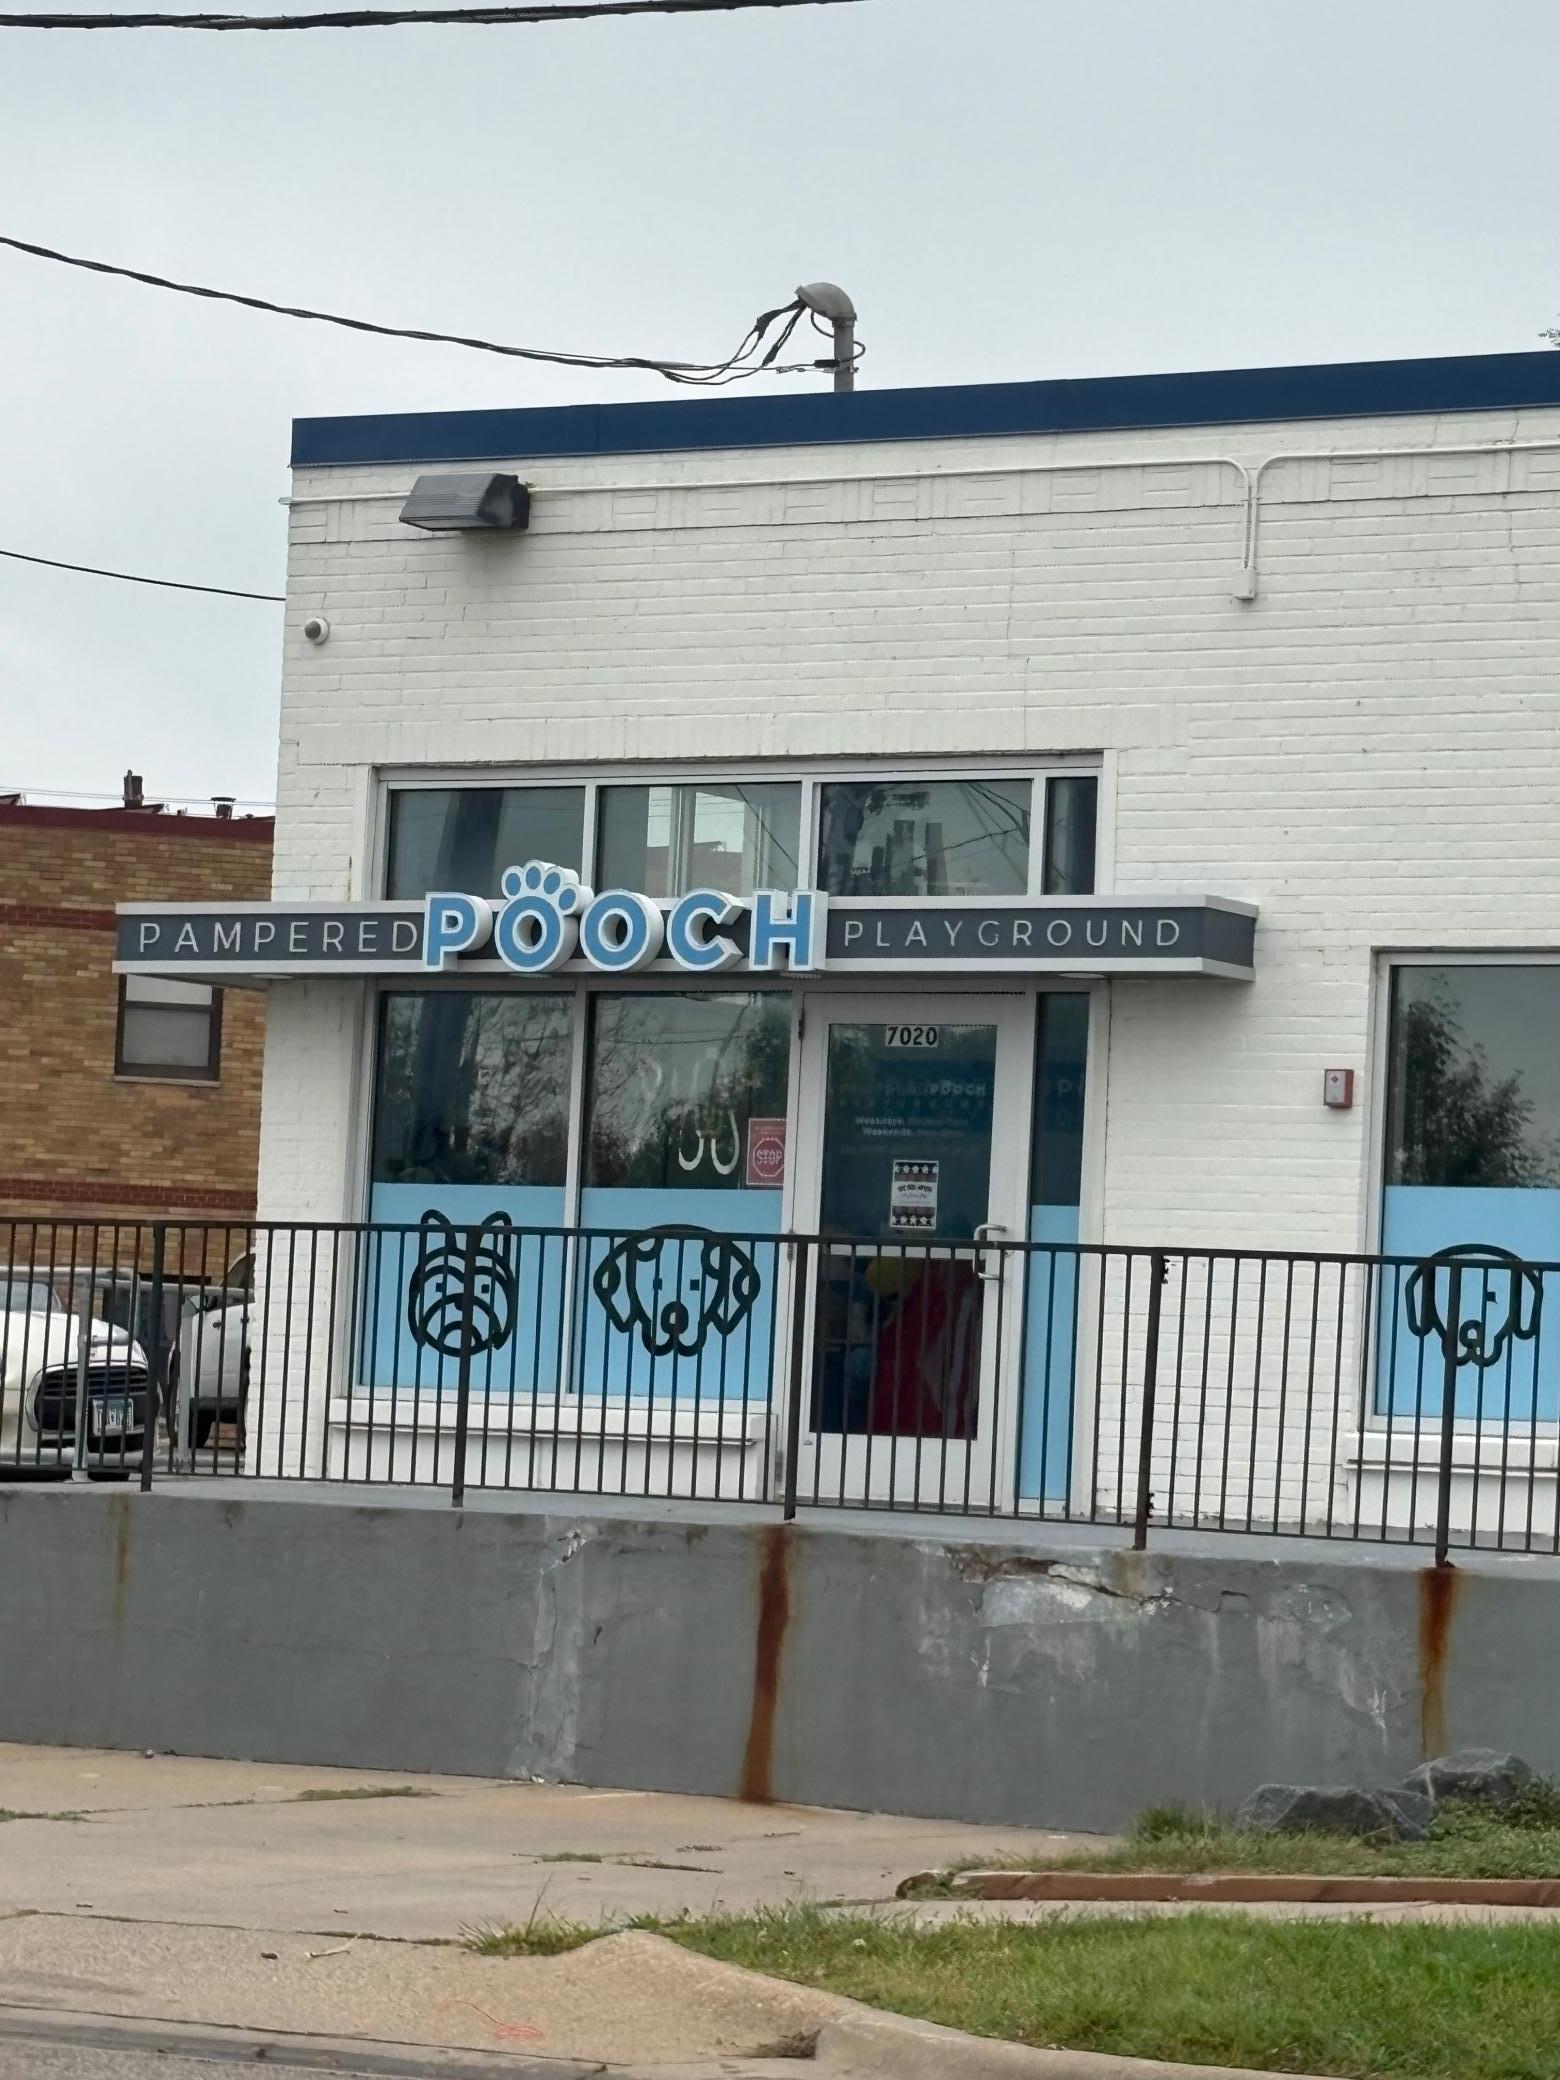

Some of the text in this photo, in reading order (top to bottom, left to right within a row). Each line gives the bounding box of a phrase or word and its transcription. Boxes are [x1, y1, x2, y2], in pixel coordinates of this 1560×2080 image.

[139, 882, 1180, 972] PAMPERED POOCH PLAYGROUND
[888, 1026, 937, 1046] 7020
[756, 1149, 783, 1165] STOP
